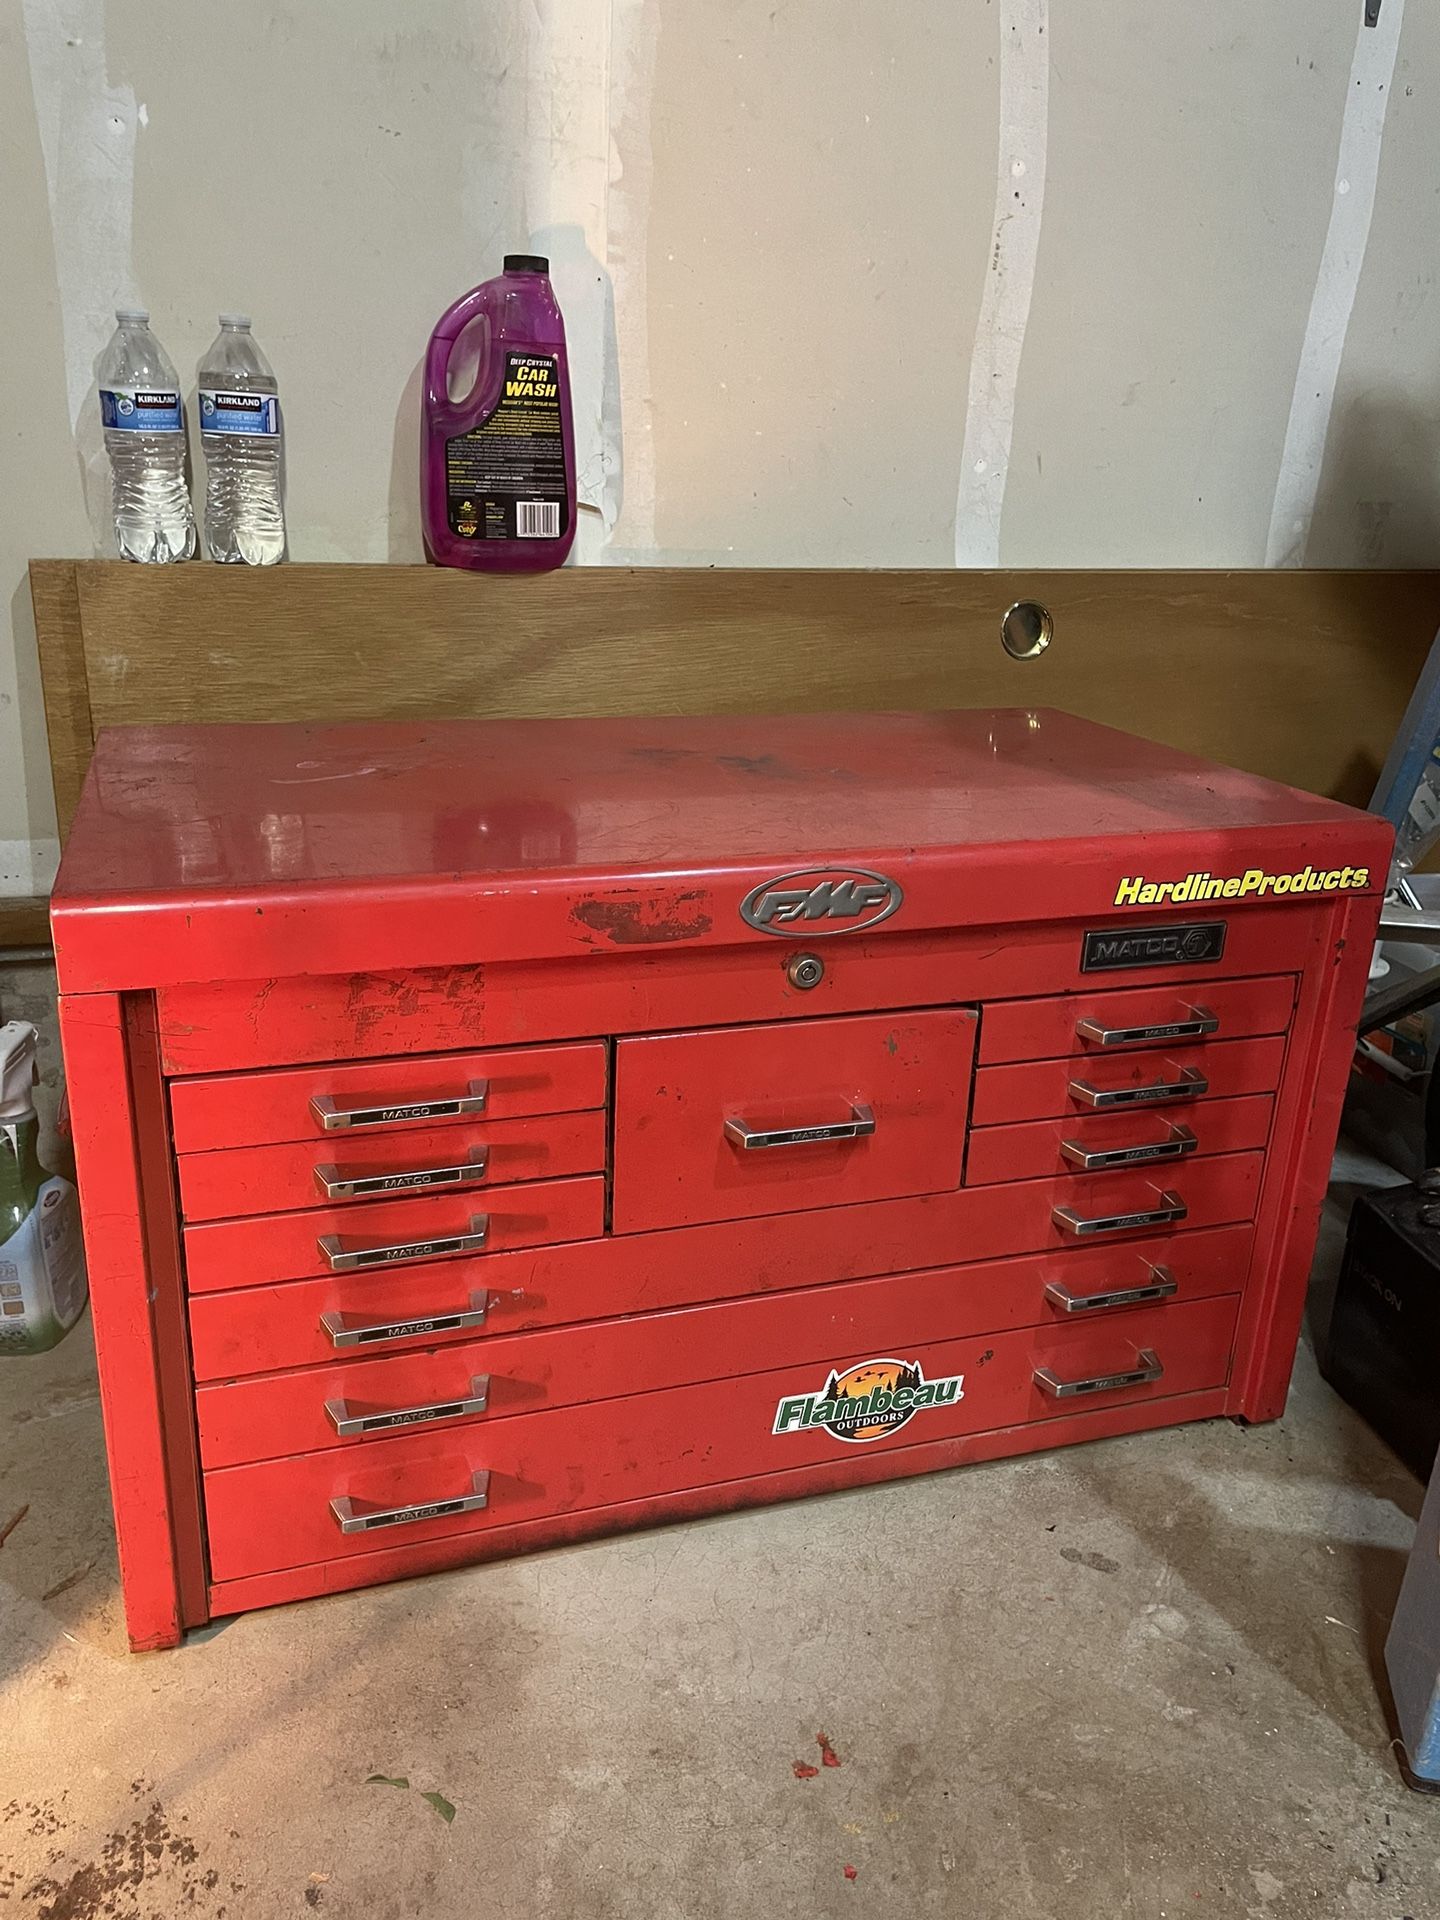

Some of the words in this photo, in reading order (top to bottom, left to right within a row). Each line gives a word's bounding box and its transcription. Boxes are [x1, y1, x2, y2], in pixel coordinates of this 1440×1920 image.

[516, 366, 548, 381] CAR
[506, 382, 556, 397] WASH
[217, 397, 260, 406] KIRKLAND
[1114, 866, 1369, 906] HardlineProducts
[753, 880, 888, 923] FMF
[1091, 937, 1179, 962] MATCO
[382, 1107, 430, 1120] MATCO
[791, 1129, 831, 1141] MATCO
[384, 1175, 431, 1188] MATCO
[386, 1245, 433, 1259] MATCO
[388, 1322, 434, 1337] MATCO
[776, 1380, 959, 1432] Flambeau
[391, 1410, 435, 1425] MATCO
[837, 1412, 904, 1431] OUTDOORS
[394, 1507, 438, 1522] MATCO
